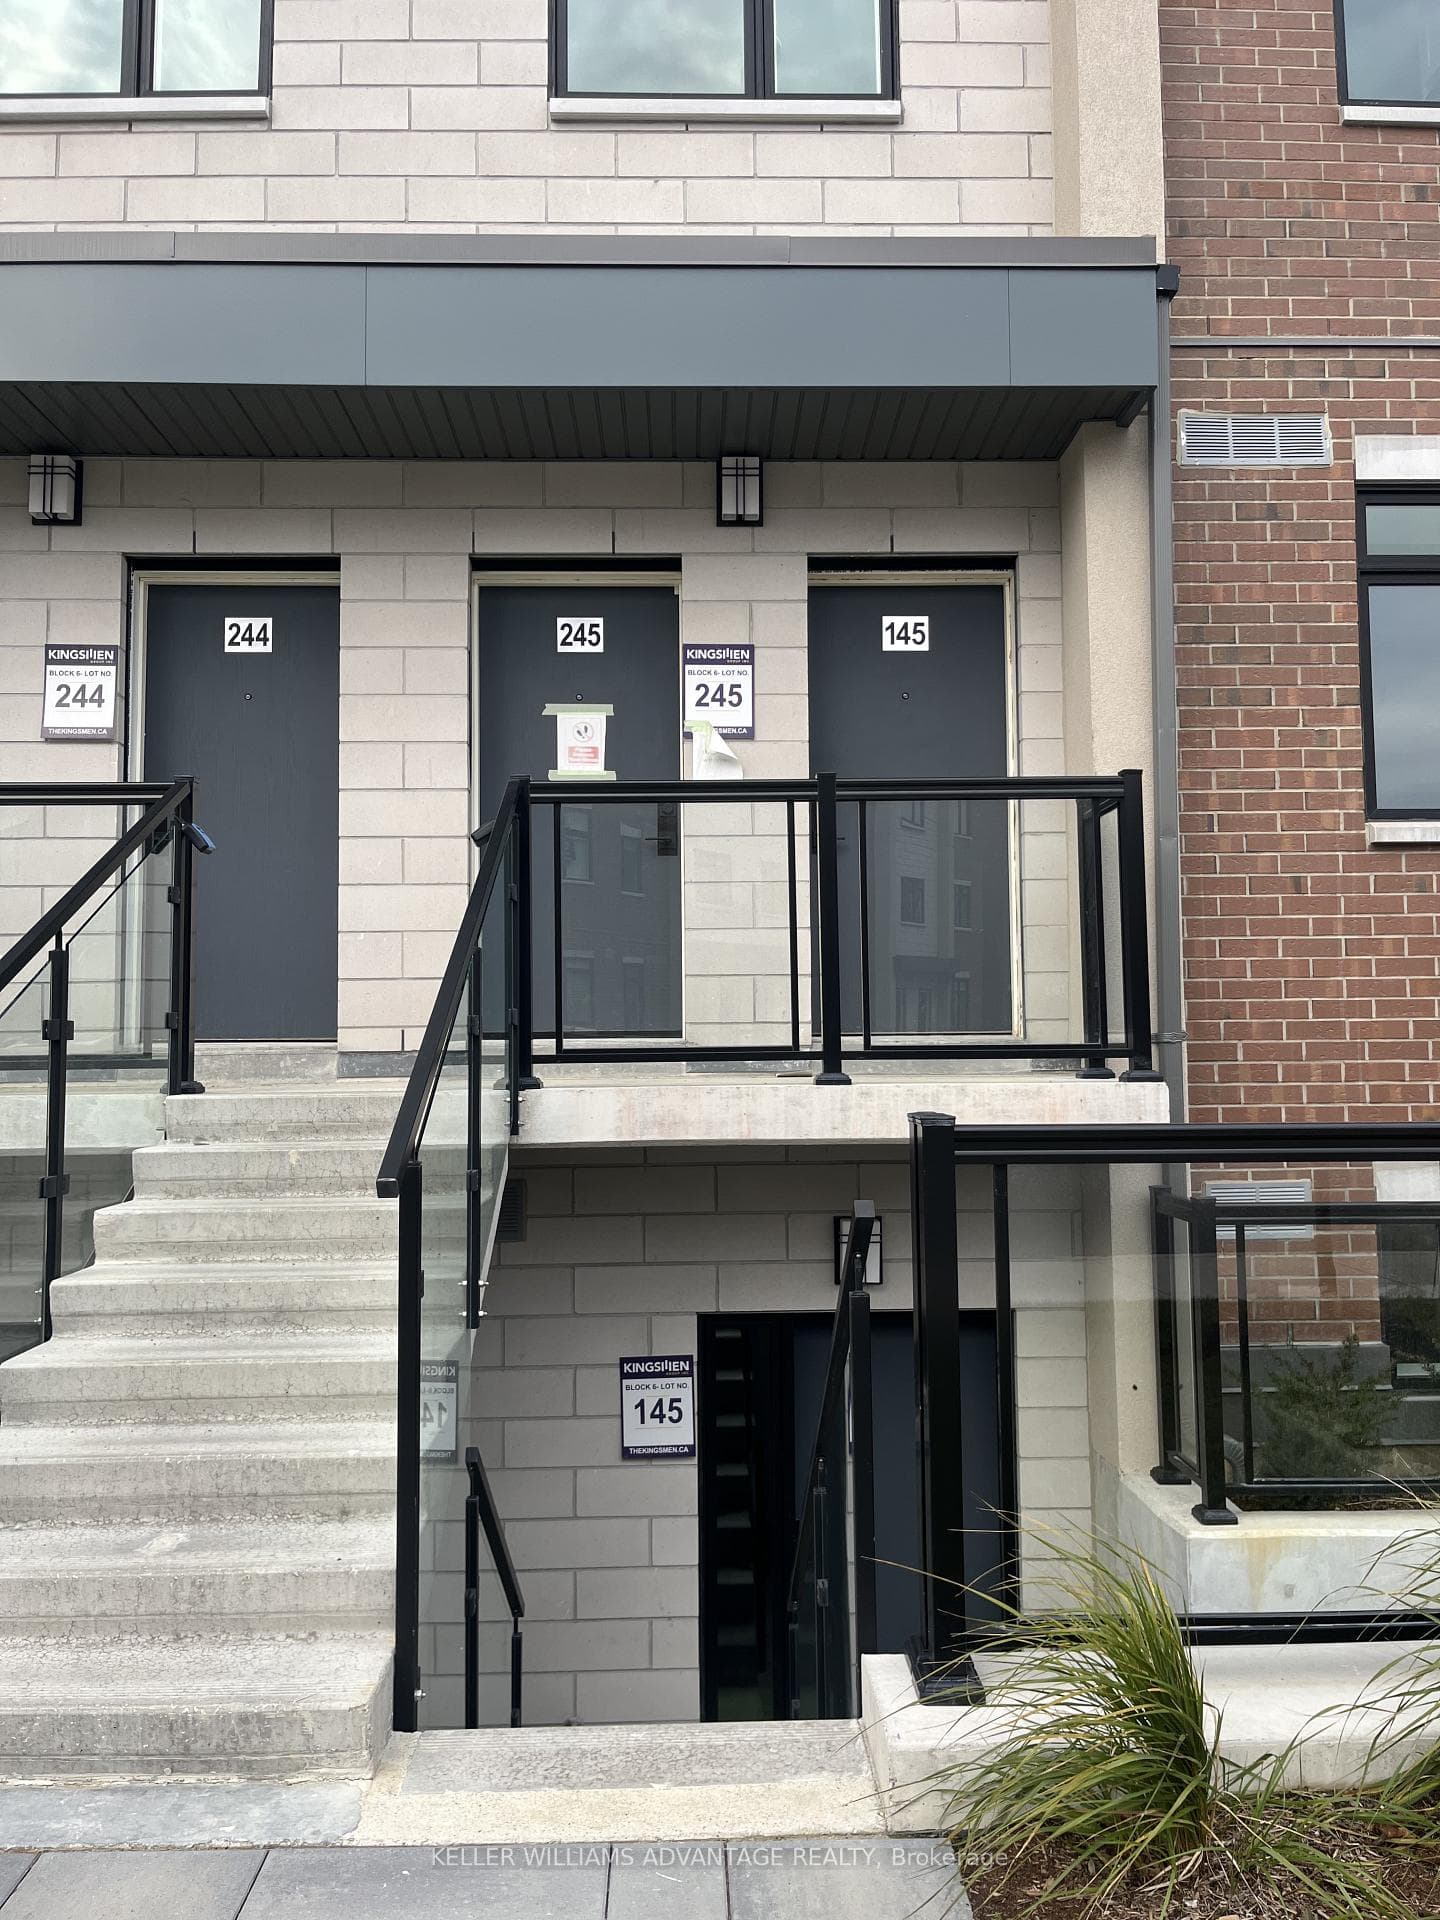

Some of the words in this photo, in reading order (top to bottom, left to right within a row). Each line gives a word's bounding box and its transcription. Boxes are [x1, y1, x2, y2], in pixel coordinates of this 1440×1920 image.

[228, 622, 270, 647] 244
[559, 622, 601, 647] 245
[885, 621, 926, 646] 145
[55, 683, 105, 708] 244
[695, 683, 743, 708] 245
[634, 1397, 683, 1425] 145
[629, 1446, 689, 1455] THEKINGSMEN.CA
